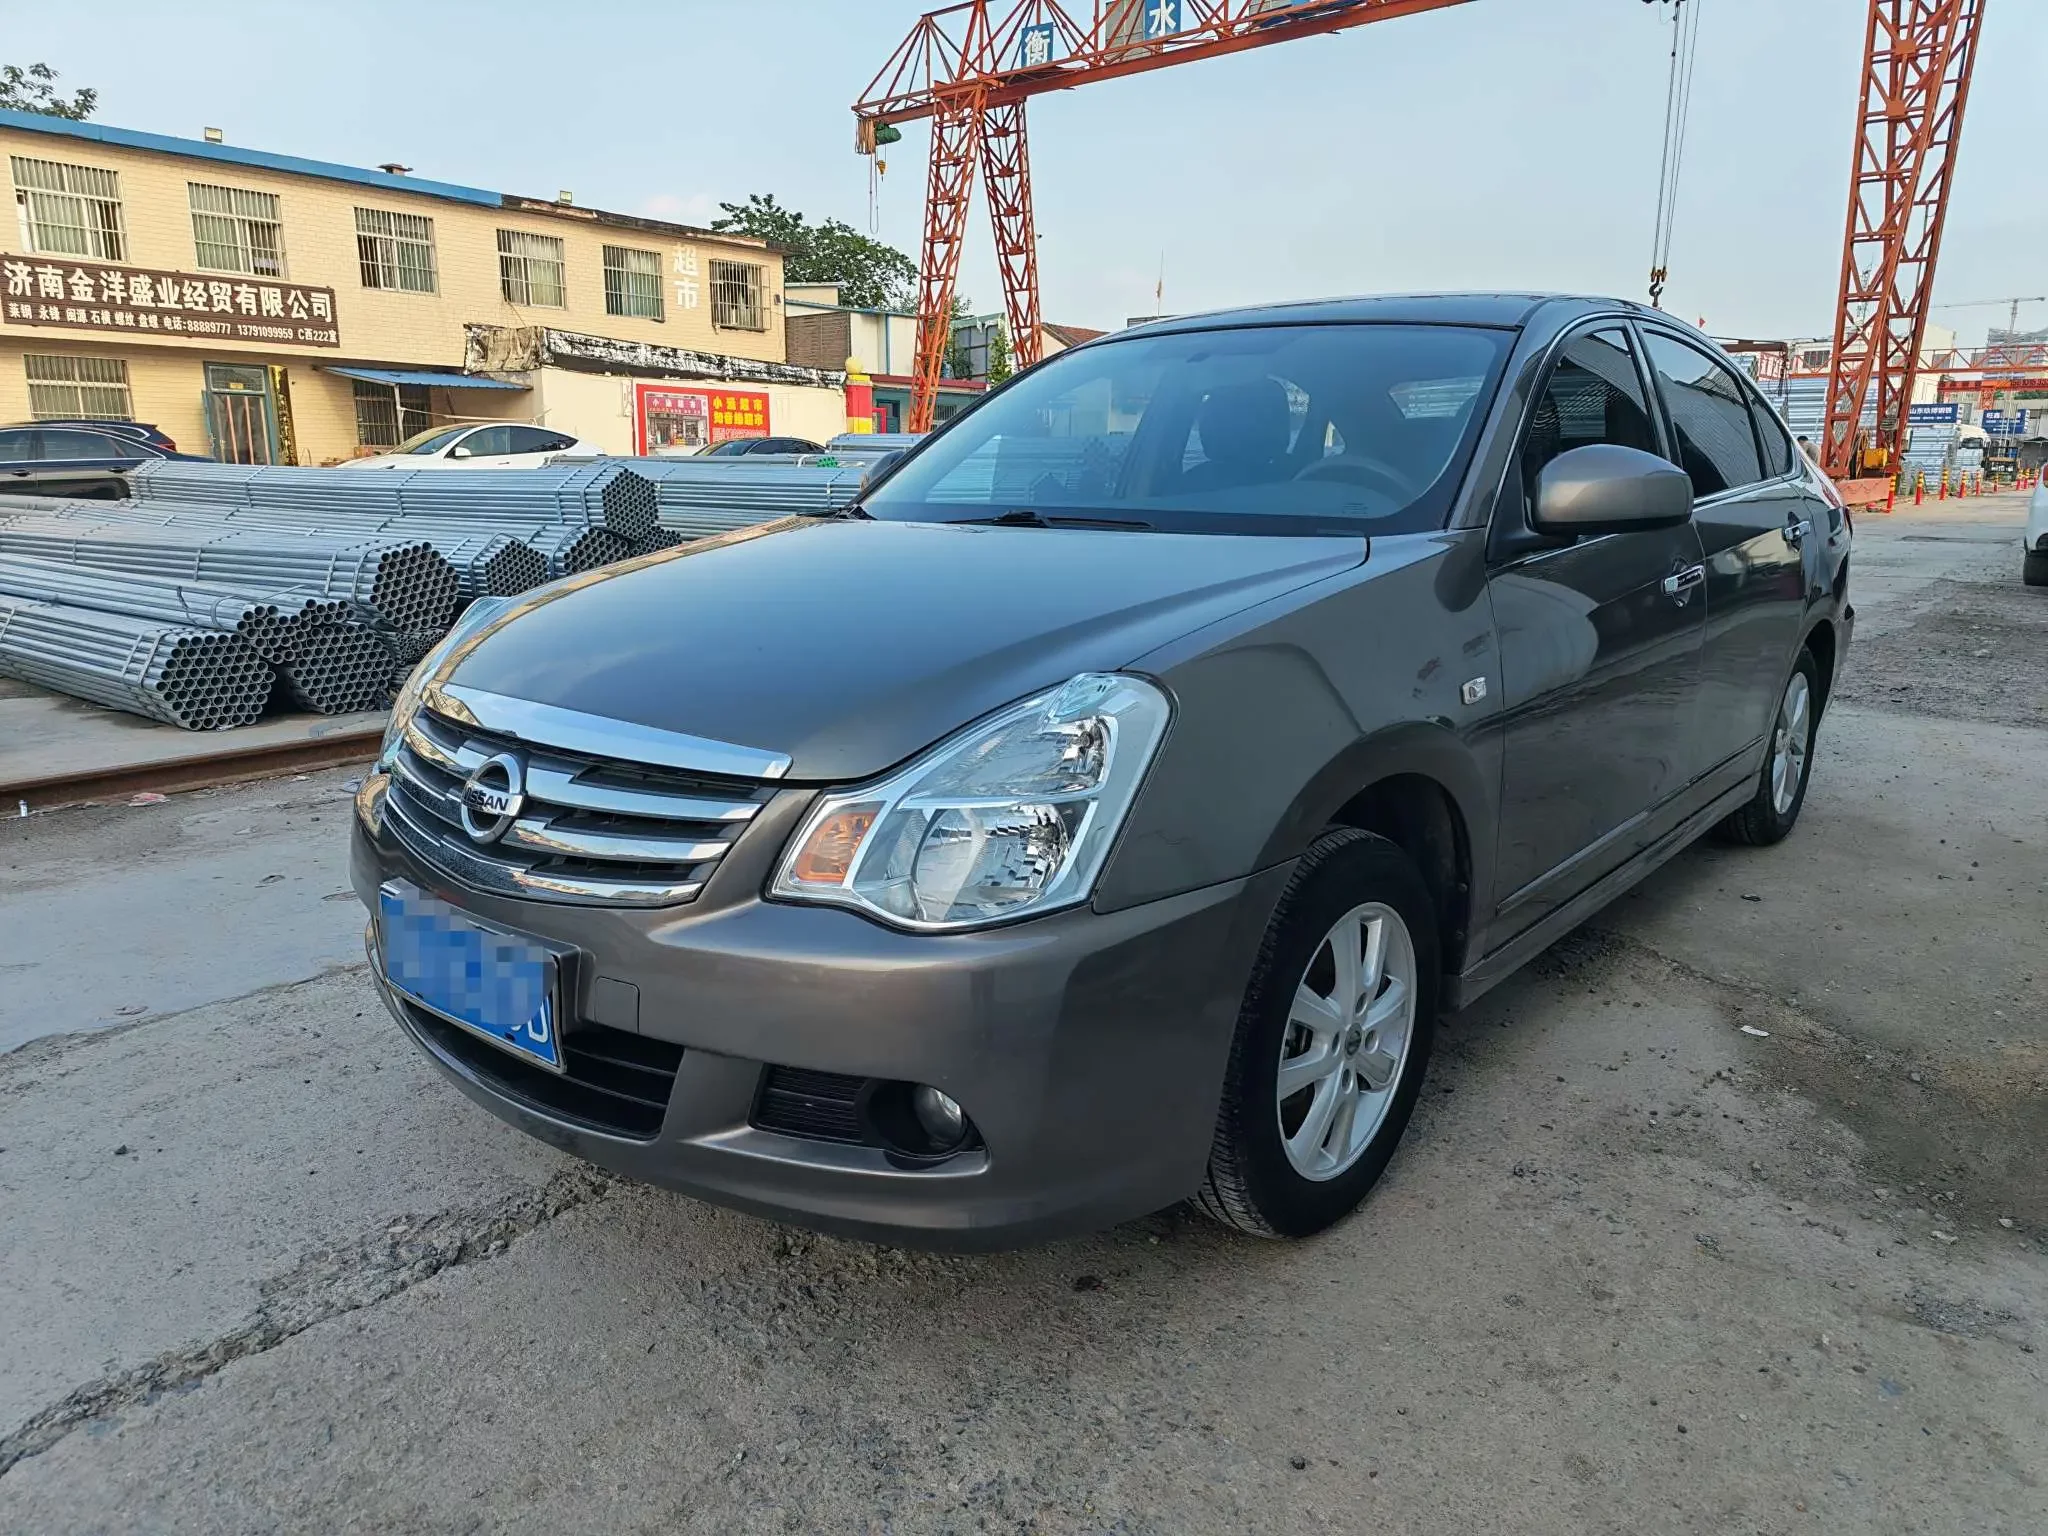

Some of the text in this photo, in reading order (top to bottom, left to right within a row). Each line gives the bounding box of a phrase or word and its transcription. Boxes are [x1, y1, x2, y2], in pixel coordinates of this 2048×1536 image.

[1025, 0, 1176, 67] 衡 水
[3, 260, 332, 323] 济南金洋盛业经贸有限公司
[673, 242, 699, 310] 超市
[237, 324, 294, 340] 13791099959
